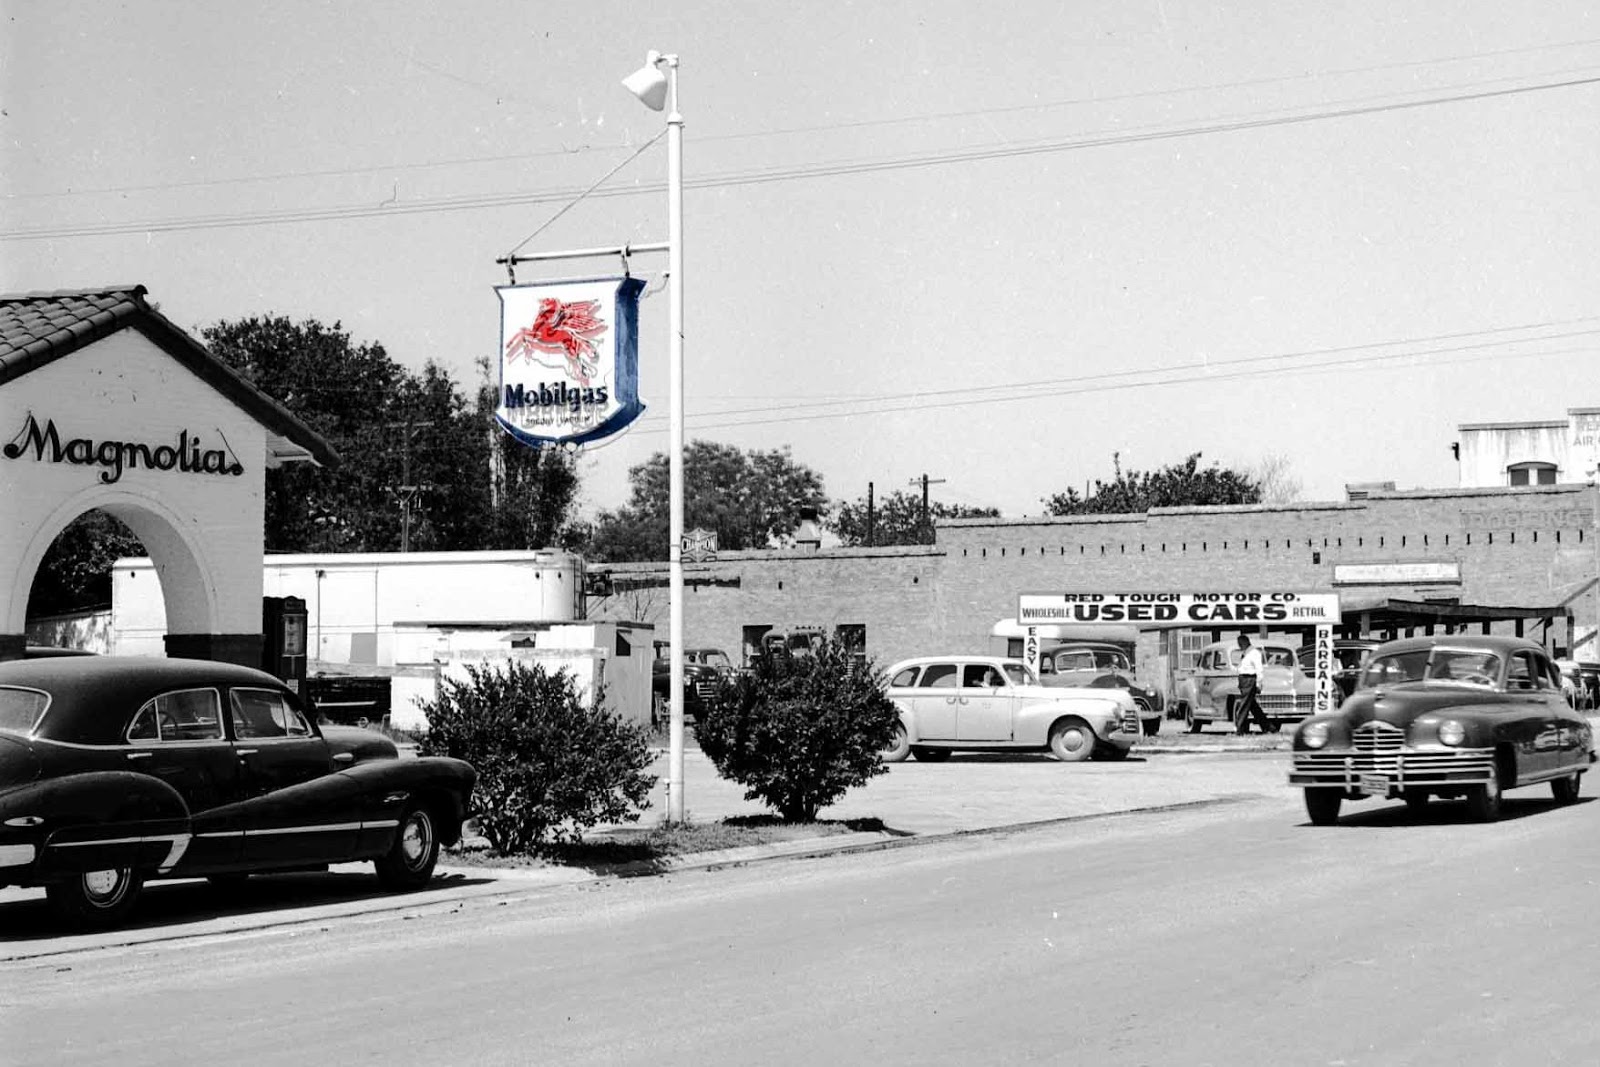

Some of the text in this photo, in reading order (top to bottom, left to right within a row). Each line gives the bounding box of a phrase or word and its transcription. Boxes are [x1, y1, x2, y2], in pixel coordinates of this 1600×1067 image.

[505, 381, 608, 412] Mobilgas
[4, 411, 244, 484] Magnolia
[1022, 603, 1326, 621] WHOLESALE USED CARS RETAIL
[1064, 592, 1301, 603] RED TOUGH MOTOR CO.
[1027, 626, 1037, 665] EASY
[1317, 629, 1329, 711] BARGAINS
